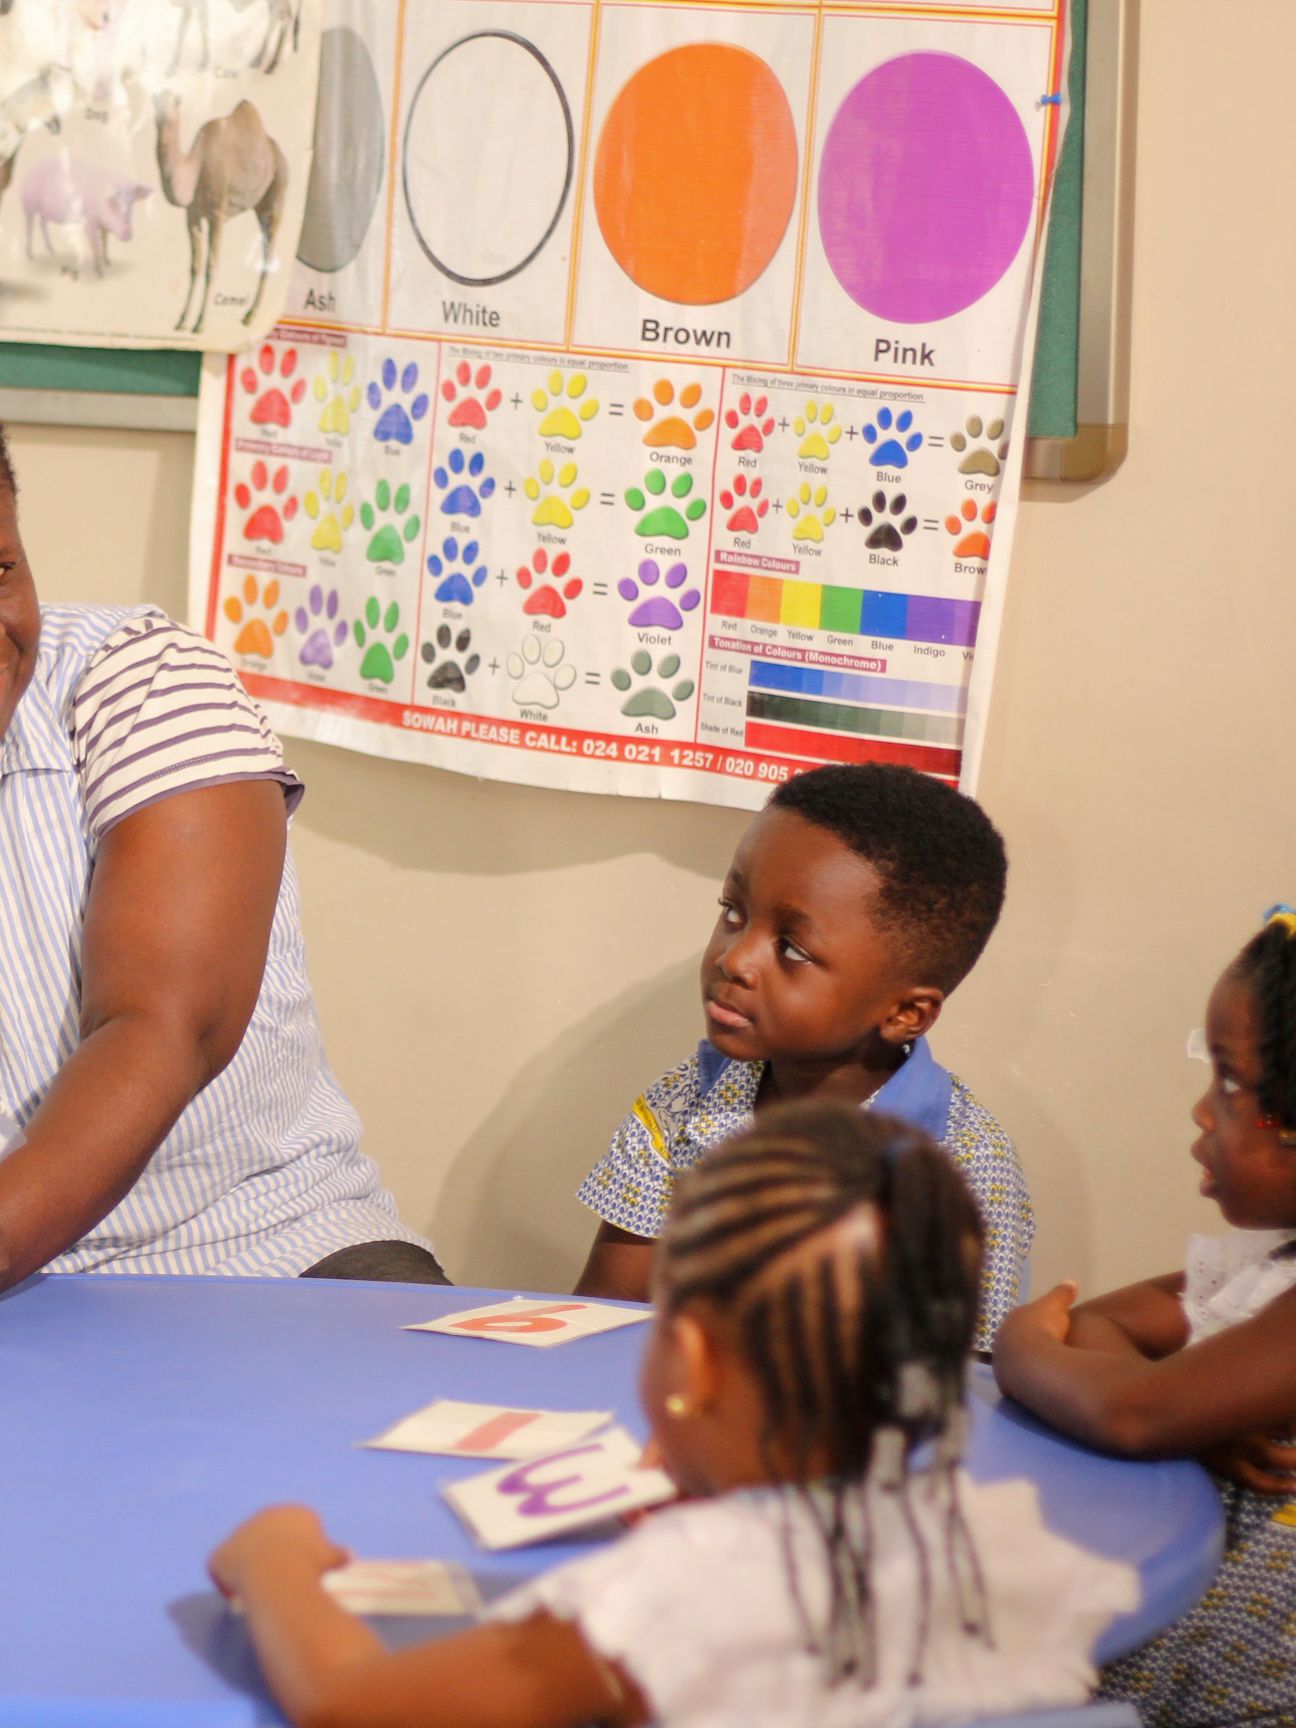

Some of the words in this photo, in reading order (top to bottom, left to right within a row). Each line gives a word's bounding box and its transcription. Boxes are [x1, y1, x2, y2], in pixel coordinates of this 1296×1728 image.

[304, 288, 338, 313] Ash
[440, 299, 502, 329] White
[641, 318, 733, 349] Brown
[873, 338, 936, 368] Pink
[544, 441, 575, 455] Yellow
[649, 451, 694, 466] Orange
[738, 455, 758, 468] Red
[798, 461, 828, 476] Yellow
[875, 471, 902, 484] Blue
[964, 479, 994, 494] Grey
[536, 531, 568, 546] Yellow
[733, 536, 752, 550] Red
[644, 542, 682, 557] Green
[791, 542, 823, 558] Yellow
[761, 557, 797, 572] Colours
[868, 553, 900, 567] Black
[954, 562, 987, 576] Brow
[533, 619, 552, 633] Red
[721, 620, 738, 631] Red
[750, 624, 779, 639] Orange
[637, 631, 673, 646] Violet
[787, 629, 815, 642] Yellow
[827, 634, 854, 648] Green
[871, 640, 894, 652] Blue
[913, 644, 946, 658] Indigo
[765, 645, 802, 660] Colours
[805, 650, 882, 672] (Monochrome)
[518, 707, 549, 722] White
[634, 722, 659, 736] Ash
[402, 709, 458, 736] SOWAH
[460, 720, 520, 746] PLEASE
[524, 731, 578, 753] CALL:
[582, 739, 618, 759] 024
[623, 741, 662, 762] 021
[670, 748, 714, 770] 1257
[725, 756, 755, 777] 020
[758, 761, 788, 782] 905
